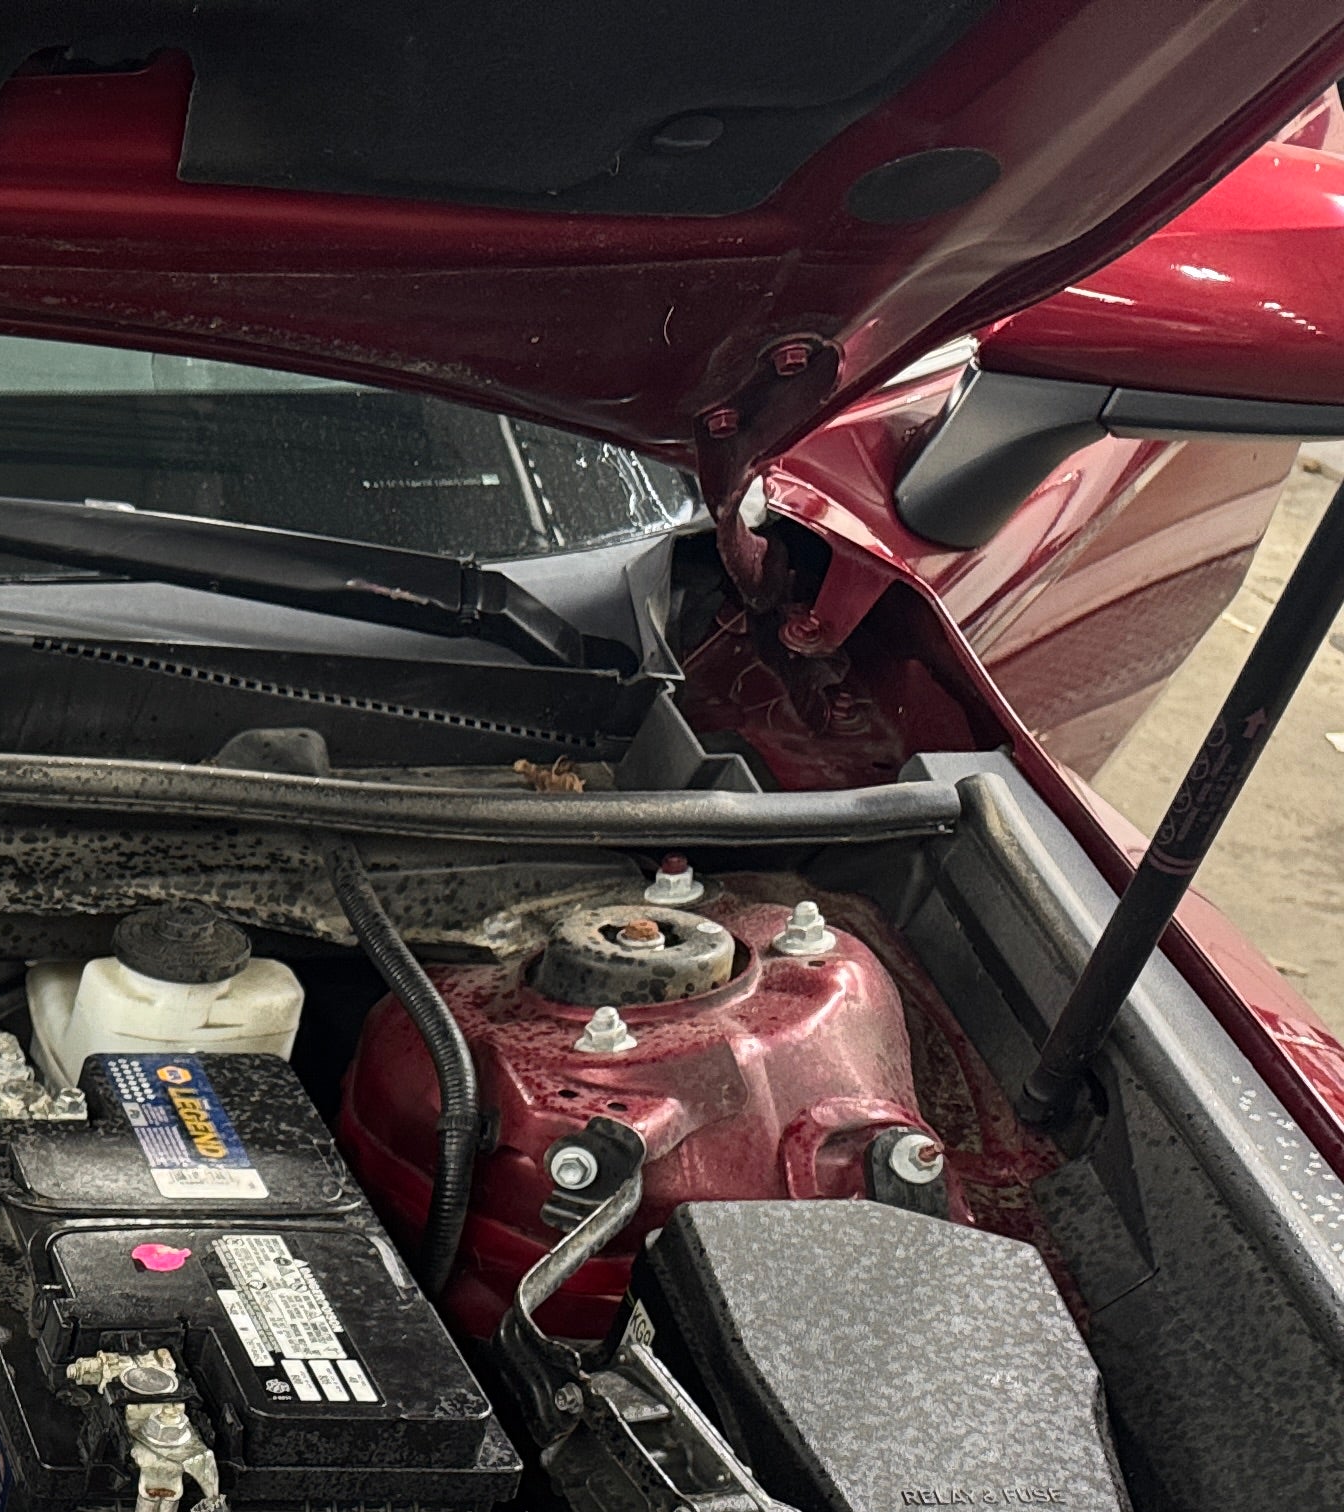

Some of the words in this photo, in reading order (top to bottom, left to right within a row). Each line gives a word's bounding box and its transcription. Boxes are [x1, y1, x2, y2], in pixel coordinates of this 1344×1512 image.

[168, 1086, 229, 1160] LEGEND
[901, 1488, 979, 1506] RELAY
[982, 1489, 998, 1505] &
[1001, 1487, 1067, 1505] FUSE
